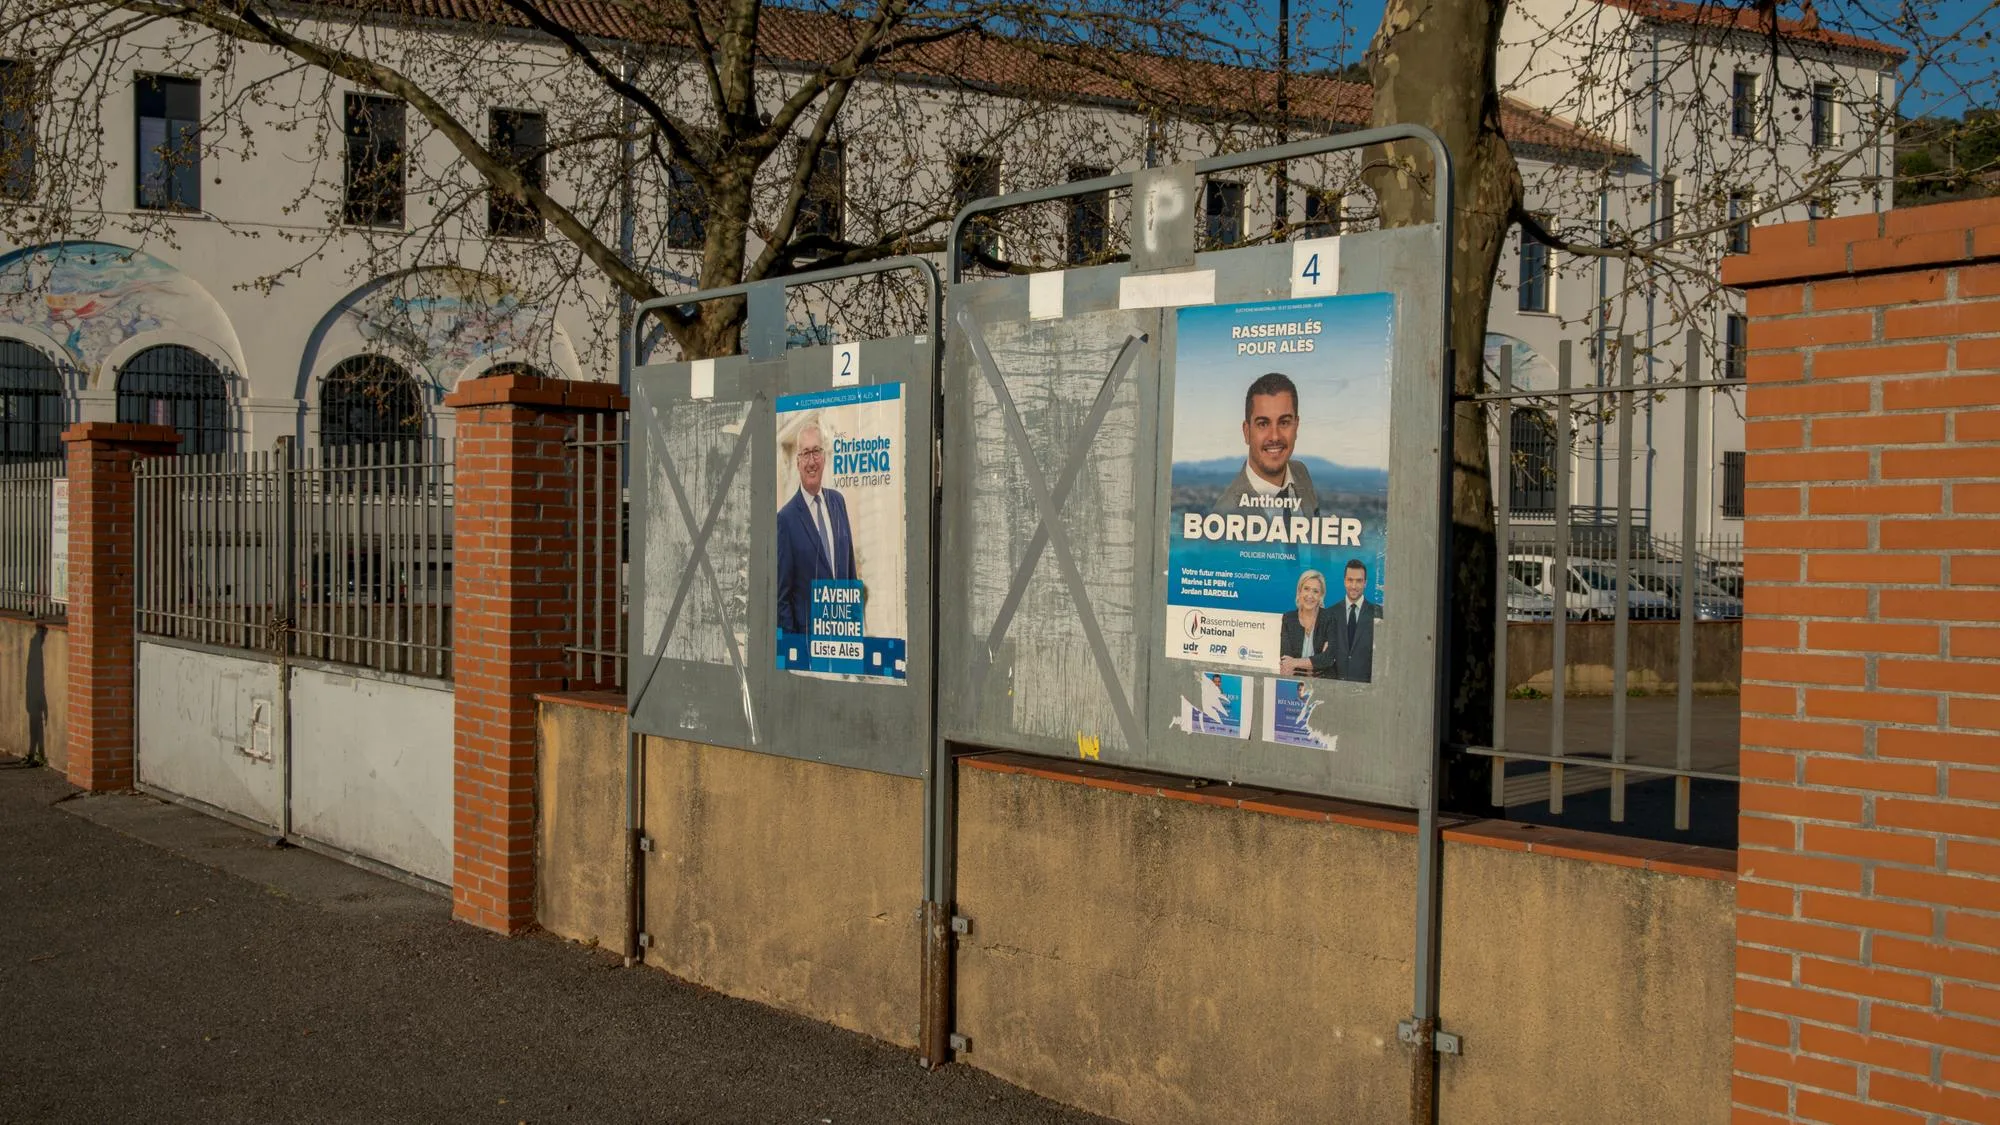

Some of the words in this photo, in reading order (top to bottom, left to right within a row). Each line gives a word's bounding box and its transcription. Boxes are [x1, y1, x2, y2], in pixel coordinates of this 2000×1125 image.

[1302, 253, 1321, 286] 4
[1232, 318, 1322, 339] RASSEMBLÉS
[1238, 341, 1277, 355] POUR
[1279, 336, 1314, 353] ALÈS
[841, 351, 851, 376] 2
[834, 435, 890, 454] Christophe
[834, 451, 890, 475] RIVENQ
[834, 475, 859, 487] votre
[862, 474, 891, 486] maire
[1239, 493, 1302, 512] Anthony
[1240, 551, 1265, 559] POLICIER
[1266, 551, 1297, 561] NATIONAL
[1181, 567, 1198, 575] Votre
[1199, 568, 1215, 577] futur
[1215, 570, 1233, 578] maire
[1234, 572, 1259, 580] soutenu
[1181, 577, 1203, 586] Marine
[1212, 579, 1227, 587] PEN
[1181, 587, 1202, 596] Jordan
[1203, 588, 1239, 599] BARDELLA
[822, 604, 830, 619] A
[831, 604, 852, 619] UNE
[1200, 616, 1265, 630] Rassemblement
[1200, 626, 1235, 638] National
[814, 642, 836, 655] Liste
[839, 643, 860, 657] Alès
[1183, 642, 1199, 652] udr
[1210, 643, 1228, 654] RPR
